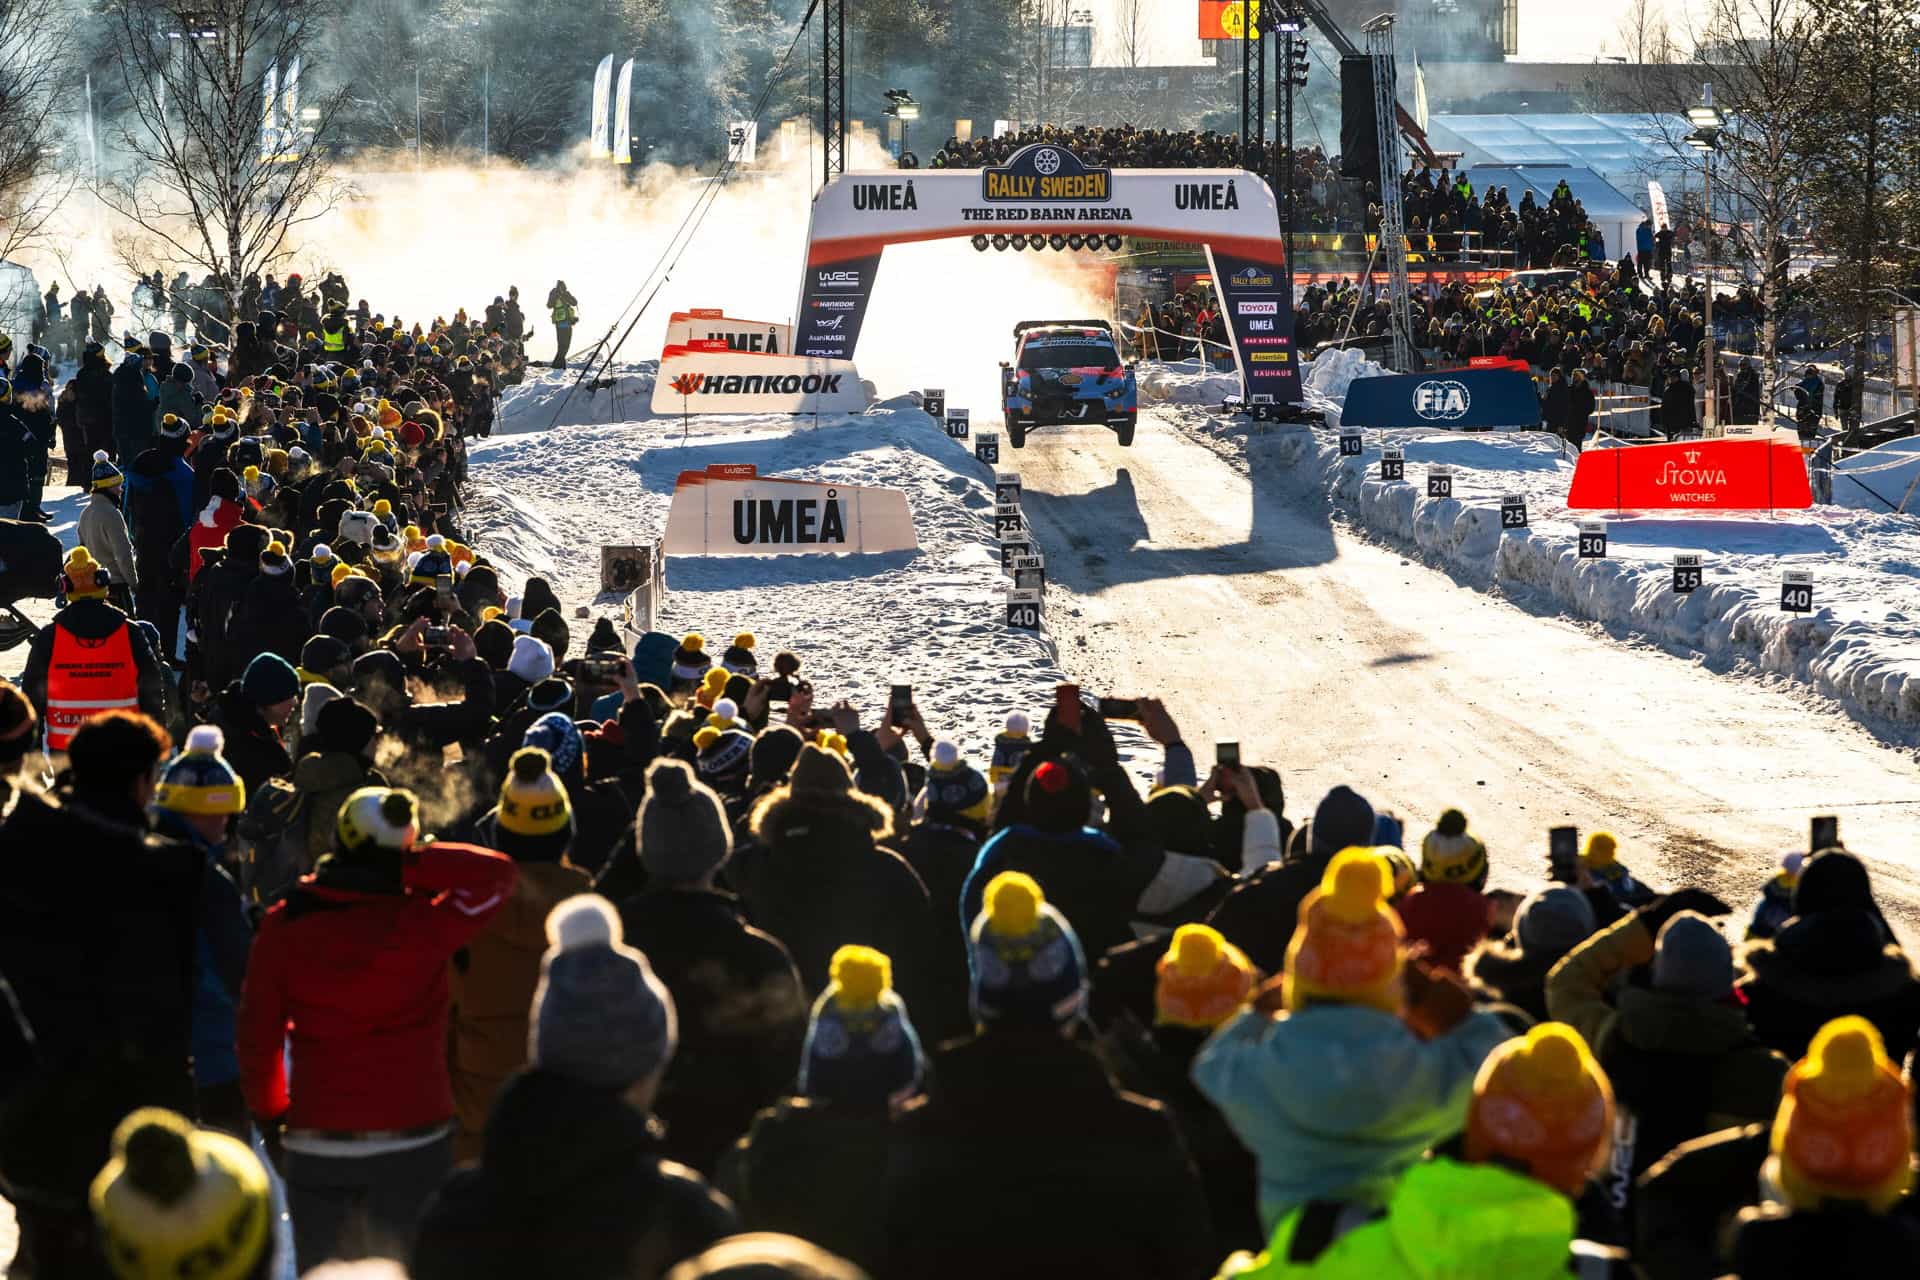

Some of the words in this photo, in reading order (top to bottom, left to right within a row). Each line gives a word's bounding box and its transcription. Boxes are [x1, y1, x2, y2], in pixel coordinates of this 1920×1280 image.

[988, 172, 1035, 198] RALLY
[1040, 173, 1105, 198] SWEDEN
[853, 179, 917, 210] UMEÅ
[1175, 179, 1239, 210] UMEÅ
[962, 208, 994, 220] THE
[996, 208, 1029, 220] RED
[1031, 208, 1075, 220] BARN
[1078, 208, 1132, 221] ARENA
[819, 271, 859, 280] WRC
[1240, 304, 1275, 312] TOYOTA
[1249, 318, 1274, 331] UMEÅ
[930, 401, 938, 413] 5
[1258, 408, 1266, 418] 5
[951, 422, 966, 434] 10
[1343, 440, 1359, 452] 10
[979, 447, 996, 460] 15
[1384, 463, 1401, 477] 15
[1655, 460, 1727, 485] STOWA
[1431, 480, 1449, 493] 20
[1670, 492, 1717, 503] WATCHES
[733, 488, 845, 544] UMEÅ
[1505, 510, 1524, 524] 25
[1582, 538, 1603, 553] 30
[1677, 572, 1698, 588] 35
[1783, 590, 1809, 608] 40
[1010, 609, 1035, 626] 40
